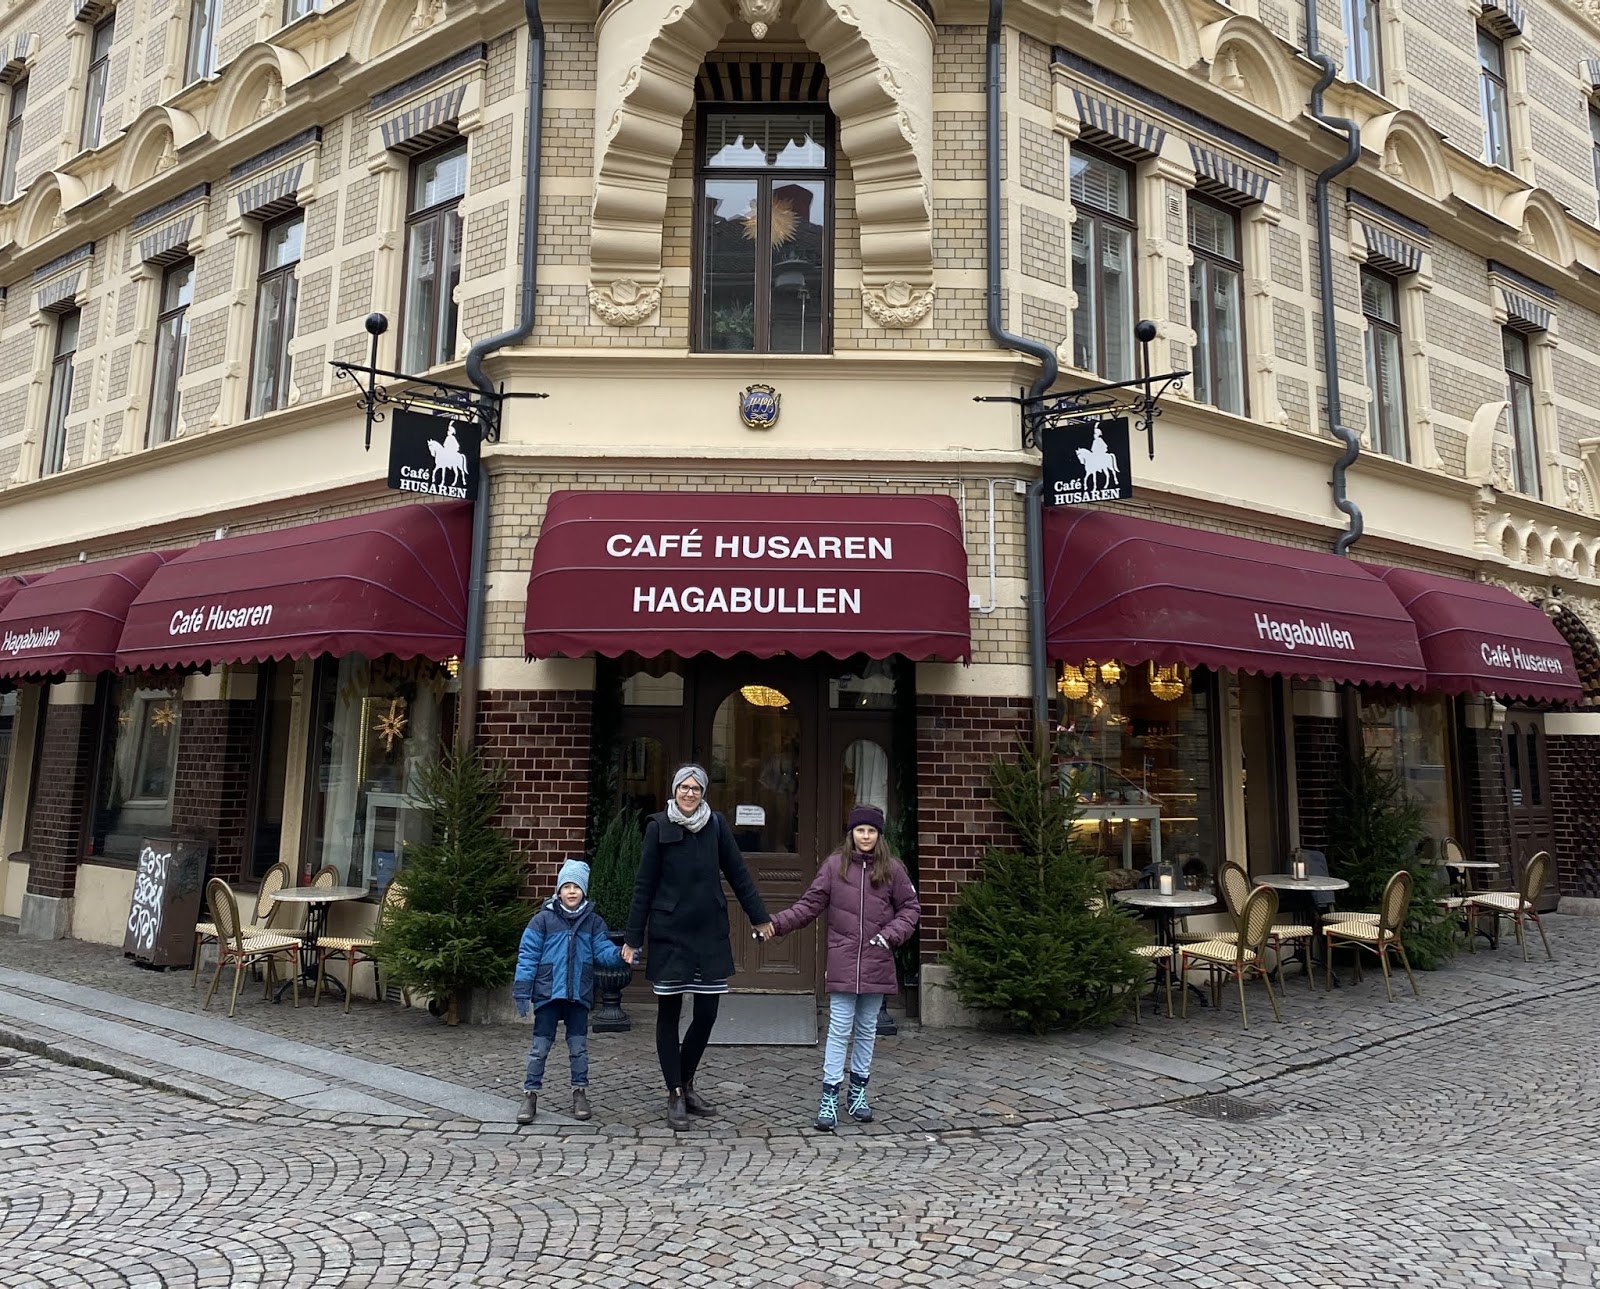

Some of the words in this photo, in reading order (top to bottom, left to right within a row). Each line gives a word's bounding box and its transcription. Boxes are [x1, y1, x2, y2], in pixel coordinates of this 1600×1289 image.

[400, 465, 430, 480] Café
[1053, 478, 1082, 492] Café
[399, 478, 467, 499] HUSAREN
[1054, 488, 1121, 505] HUSAREN
[606, 528, 703, 559] CAFÉ
[714, 535, 893, 560] HUSAREN
[632, 586, 862, 614] HAGABULLEN
[169, 605, 205, 635] Café
[205, 604, 273, 631] Husaren
[1254, 613, 1355, 650] Hagabullen
[1, 626, 61, 656] Hagabullen
[1480, 642, 1511, 668] Café
[1511, 647, 1563, 674] Husaren
